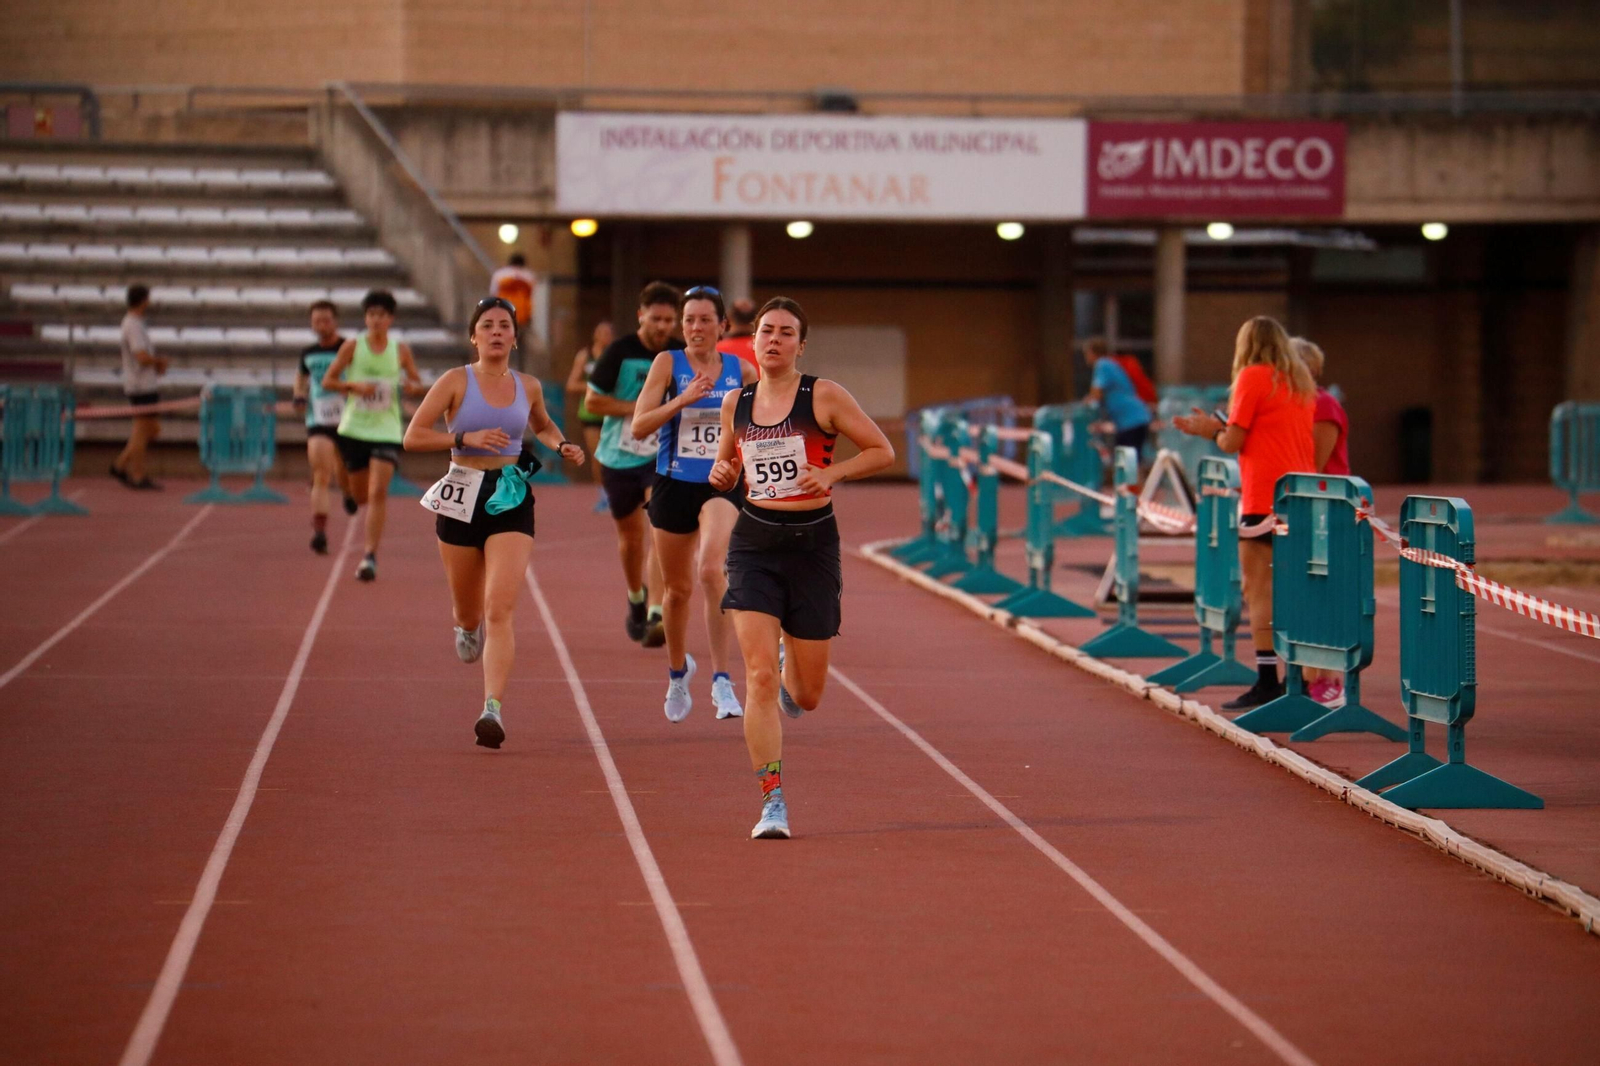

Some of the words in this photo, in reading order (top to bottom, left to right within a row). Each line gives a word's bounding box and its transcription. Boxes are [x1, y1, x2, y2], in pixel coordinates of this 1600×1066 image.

[771, 128, 899, 151] DEPORTIVA
[909, 130, 1040, 154] MUNICIPAL
[1152, 136, 1334, 180] IMDECO
[712, 156, 931, 204] FONTANAR
[755, 459, 798, 484] 599
